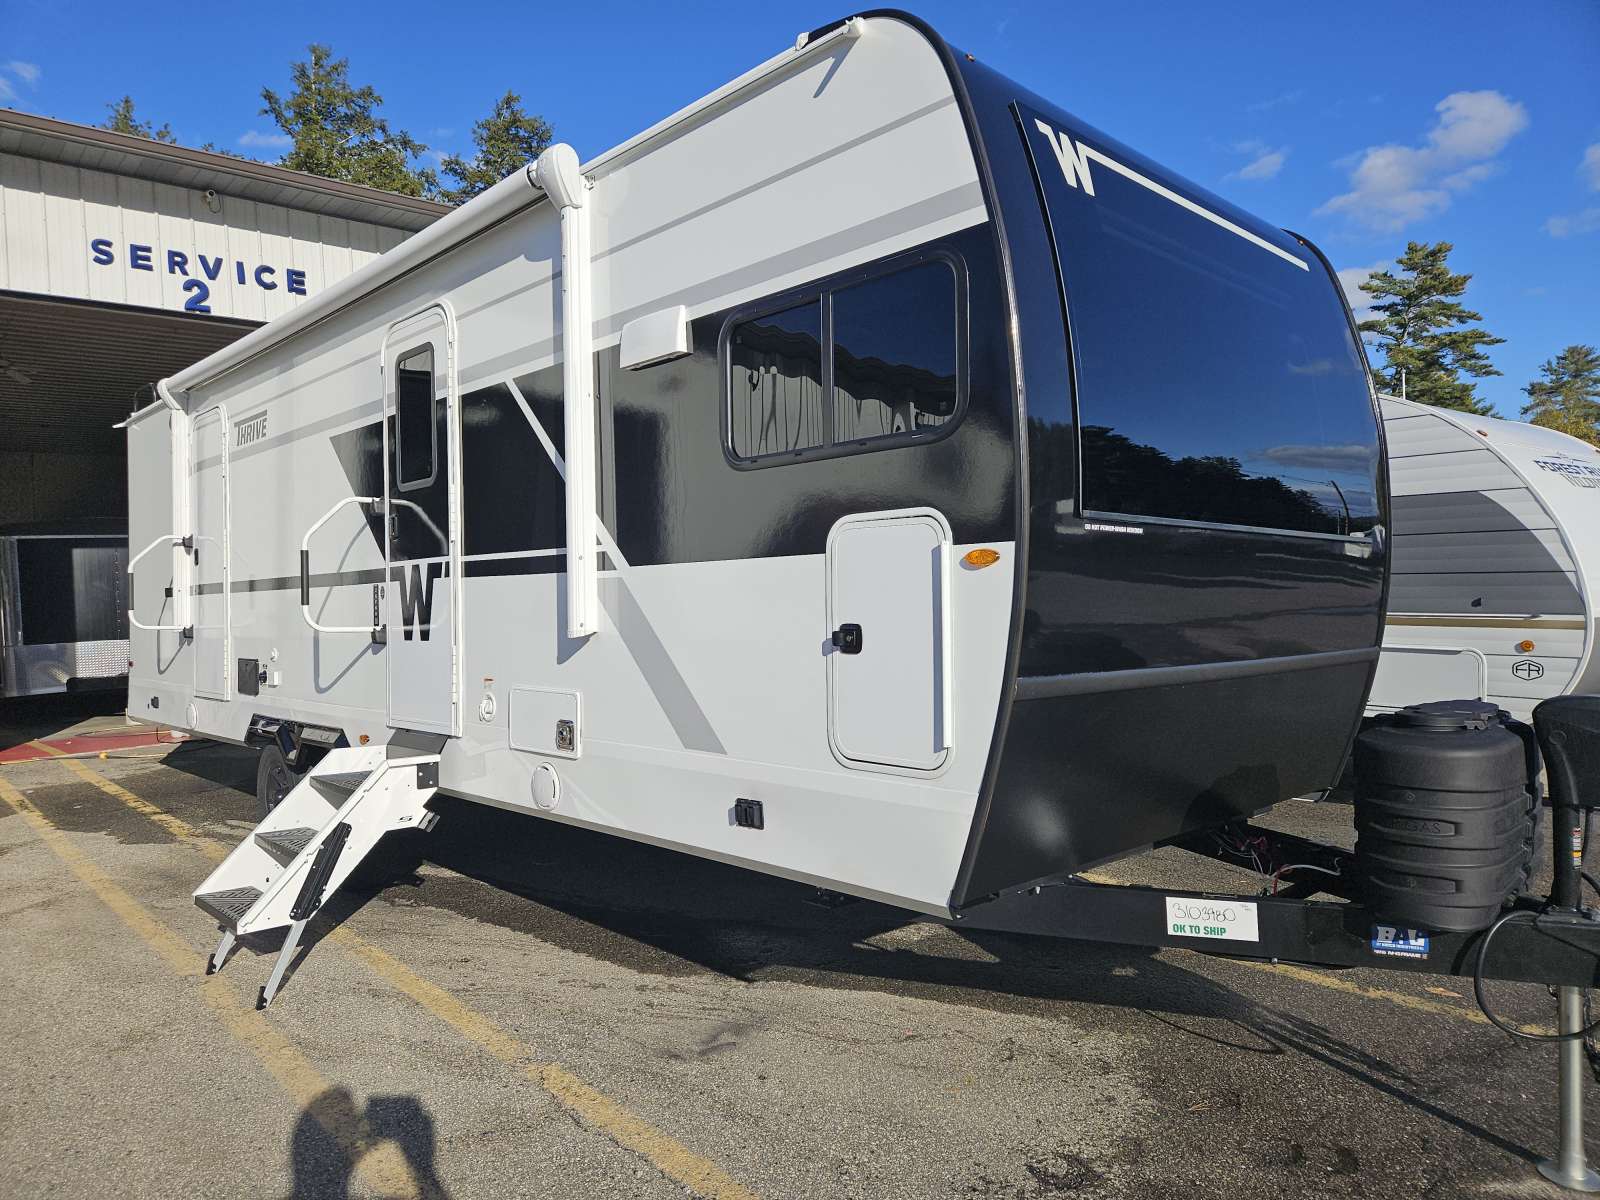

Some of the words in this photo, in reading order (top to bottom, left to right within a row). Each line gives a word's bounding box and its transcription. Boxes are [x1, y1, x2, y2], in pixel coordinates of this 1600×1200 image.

[91, 238, 307, 296] SERVICE
[182, 278, 212, 314] 2
[233, 409, 268, 447] THRIVE
[1534, 460, 1587, 475] FOREST
[1172, 923, 1186, 934] OK
[1188, 925, 1201, 935] TO
[1203, 926, 1227, 936] SHIP
